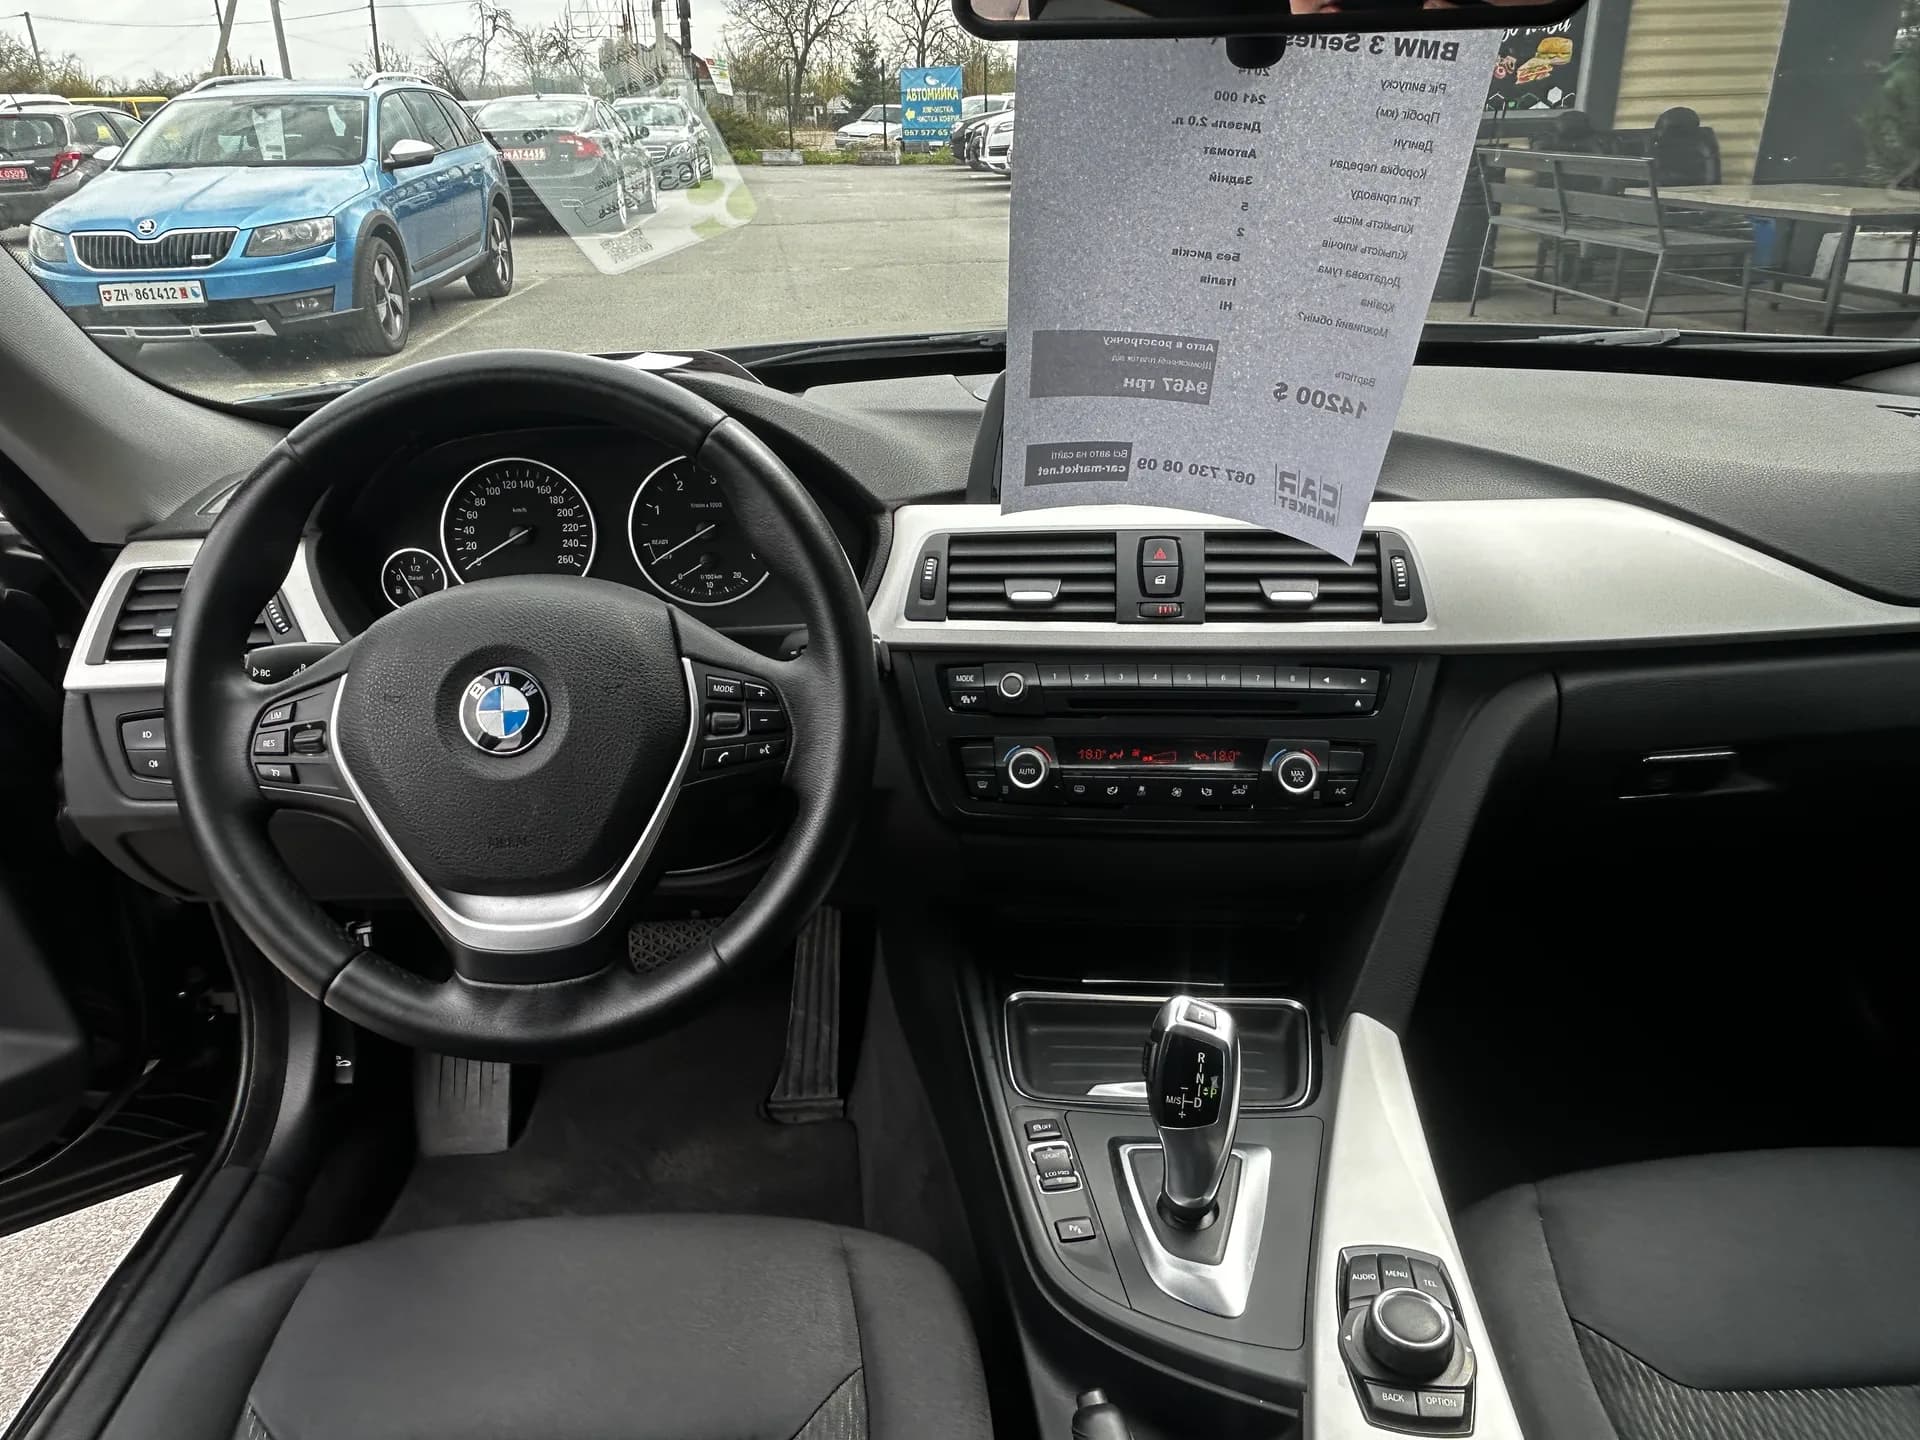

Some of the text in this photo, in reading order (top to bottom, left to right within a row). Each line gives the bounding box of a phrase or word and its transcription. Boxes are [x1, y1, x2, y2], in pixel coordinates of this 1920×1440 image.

[906, 83, 959, 102] АВТОМИЙКА
[113, 287, 178, 302] ZH 861412
[502, 480, 517, 489] 120
[519, 480, 534, 488] 140
[676, 480, 684, 492] 2
[486, 486, 500, 496] 100
[536, 485, 552, 494] 160
[474, 498, 486, 506] 80
[550, 496, 564, 504] 180
[557, 508, 574, 518] 200
[654, 504, 660, 516] 1
[466, 510, 478, 520] 60
[463, 526, 475, 534] 40
[562, 524, 579, 532] 220
[466, 541, 478, 550] 20
[562, 539, 579, 548] 240
[558, 554, 574, 564] 260
[732, 571, 742, 579] 20
[955, 674, 975, 683] MODE
[1052, 672, 1057, 680] 1
[1084, 673, 1090, 681] 2
[1118, 672, 1124, 681] 3
[1152, 673, 1158, 681] 4
[1186, 673, 1192, 682] 5
[1220, 674, 1226, 682] 6
[469, 671, 538, 700] BMW
[713, 684, 735, 694] MODE
[1018, 768, 1036, 776] AUTO
[1198, 1052, 1206, 1064] R
[1196, 1072, 1204, 1084] N
[1166, 1095, 1182, 1105] M/S
[1193, 1097, 1202, 1108] D
[1352, 1272, 1376, 1281] AUDIO
[1385, 1270, 1408, 1278] MENU
[1424, 1279, 1438, 1288] TEL
[1382, 1392, 1405, 1403] BACK
[1426, 1396, 1457, 1408] OPTION
